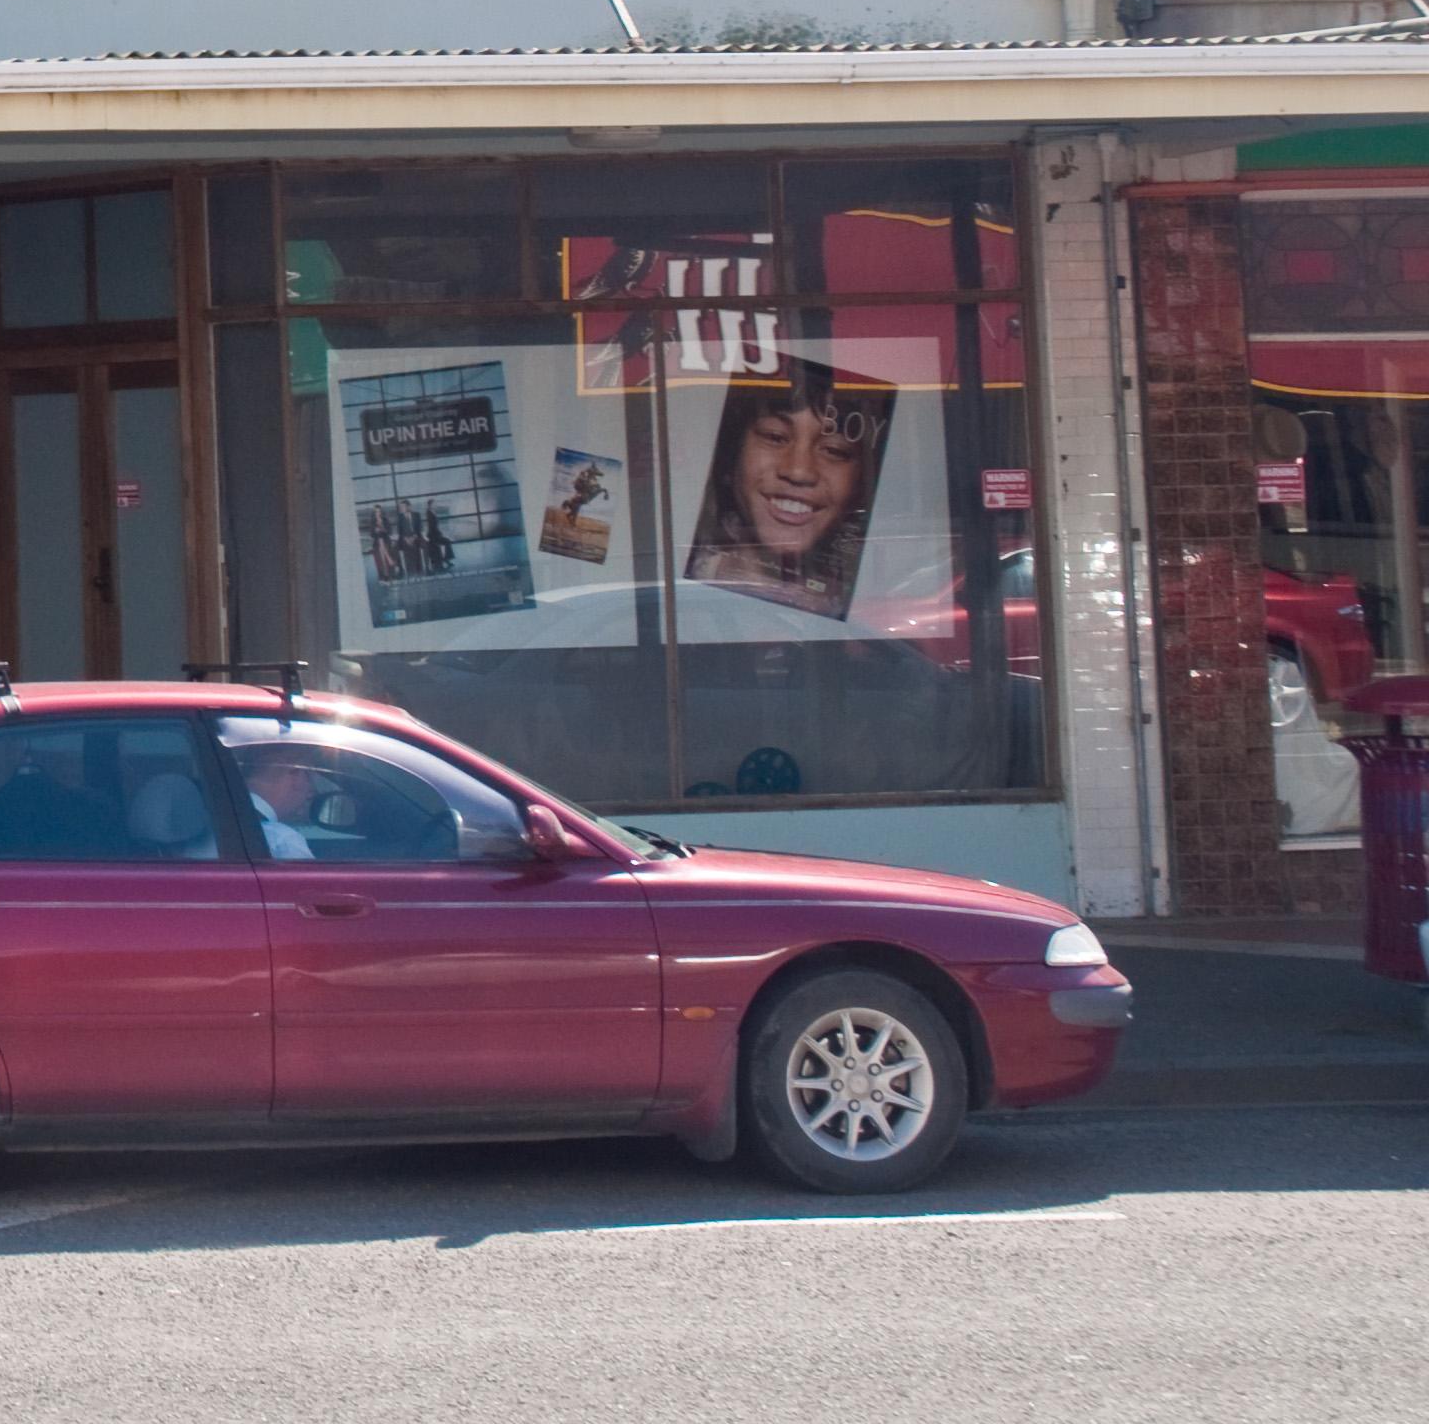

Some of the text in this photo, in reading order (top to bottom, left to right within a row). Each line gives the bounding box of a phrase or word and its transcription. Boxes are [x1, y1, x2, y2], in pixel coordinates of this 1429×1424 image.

[368, 427, 395, 446] UP
[397, 426, 418, 443] IN
[417, 419, 455, 439] THE
[457, 416, 490, 435] AIR
[820, 404, 887, 449] BOY
